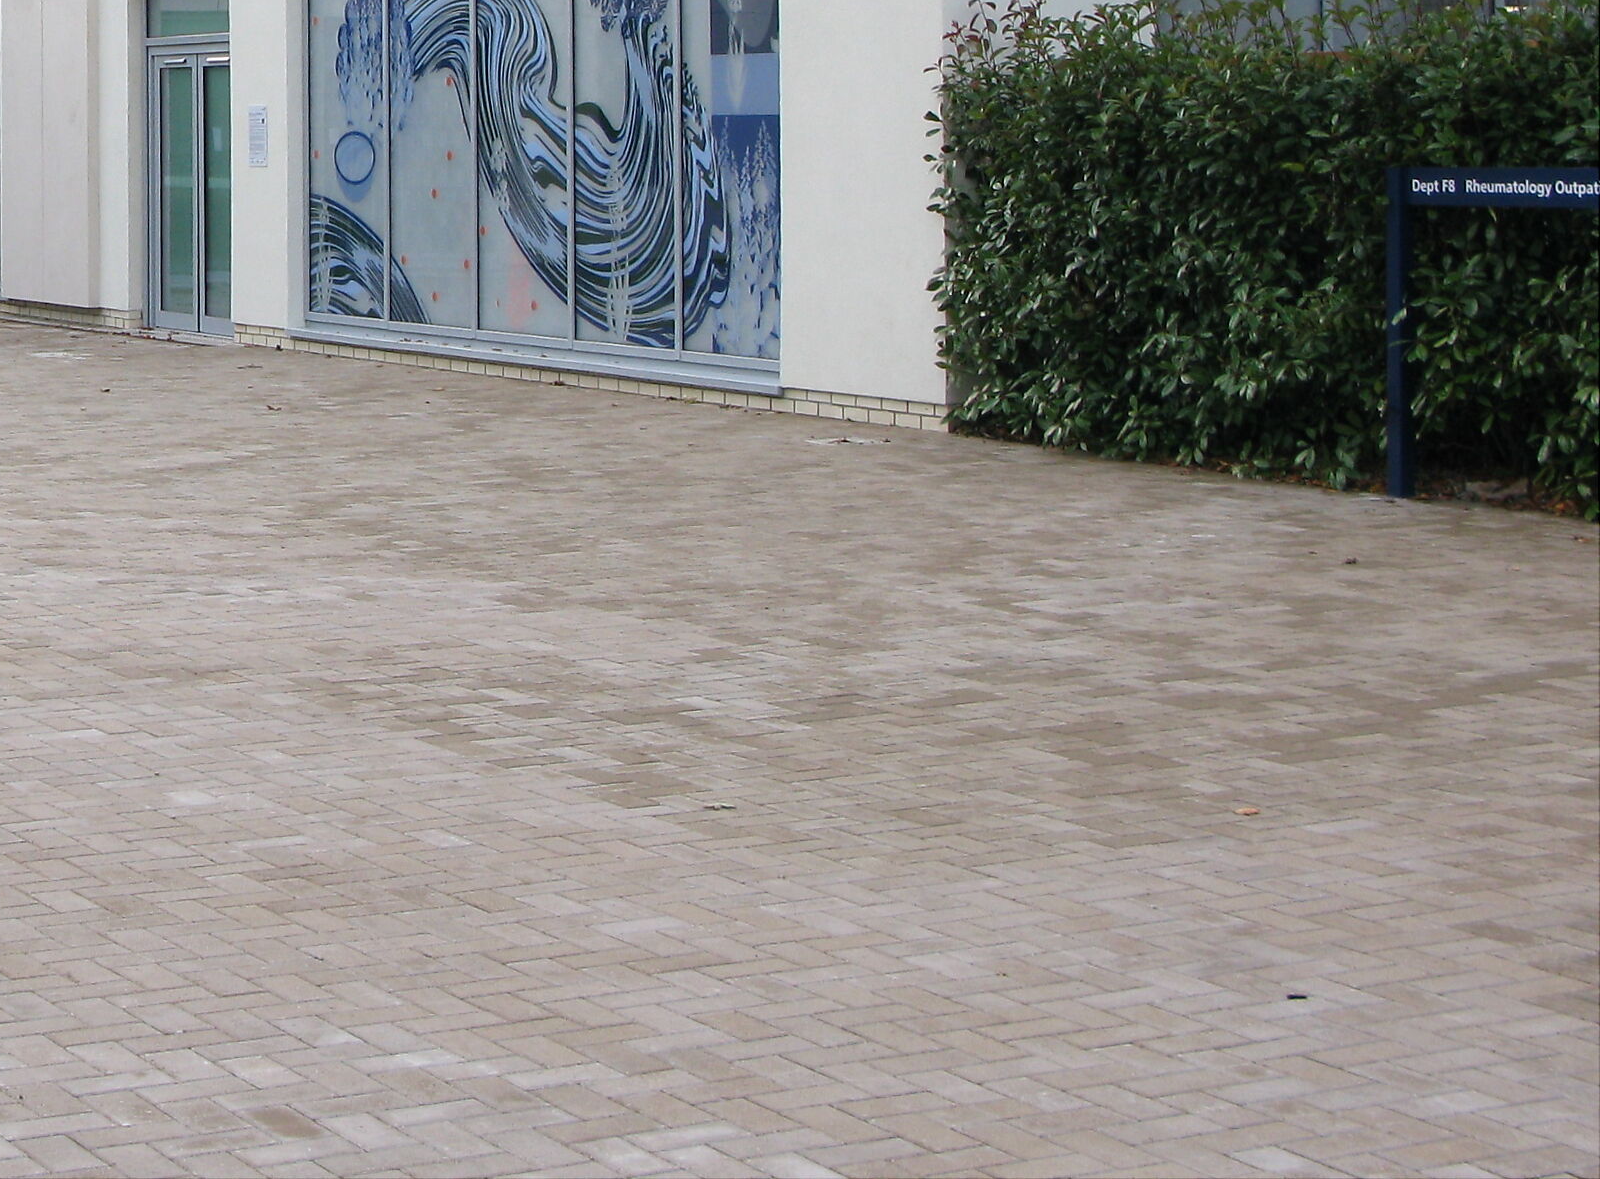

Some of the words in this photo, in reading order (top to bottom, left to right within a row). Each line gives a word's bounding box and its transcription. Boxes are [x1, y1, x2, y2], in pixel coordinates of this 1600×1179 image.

[1411, 178, 1439, 196] Dept
[1442, 179, 1456, 193] F8
[1465, 178, 1552, 198] Rheumatology
[1555, 180, 1600, 198] Outpat
